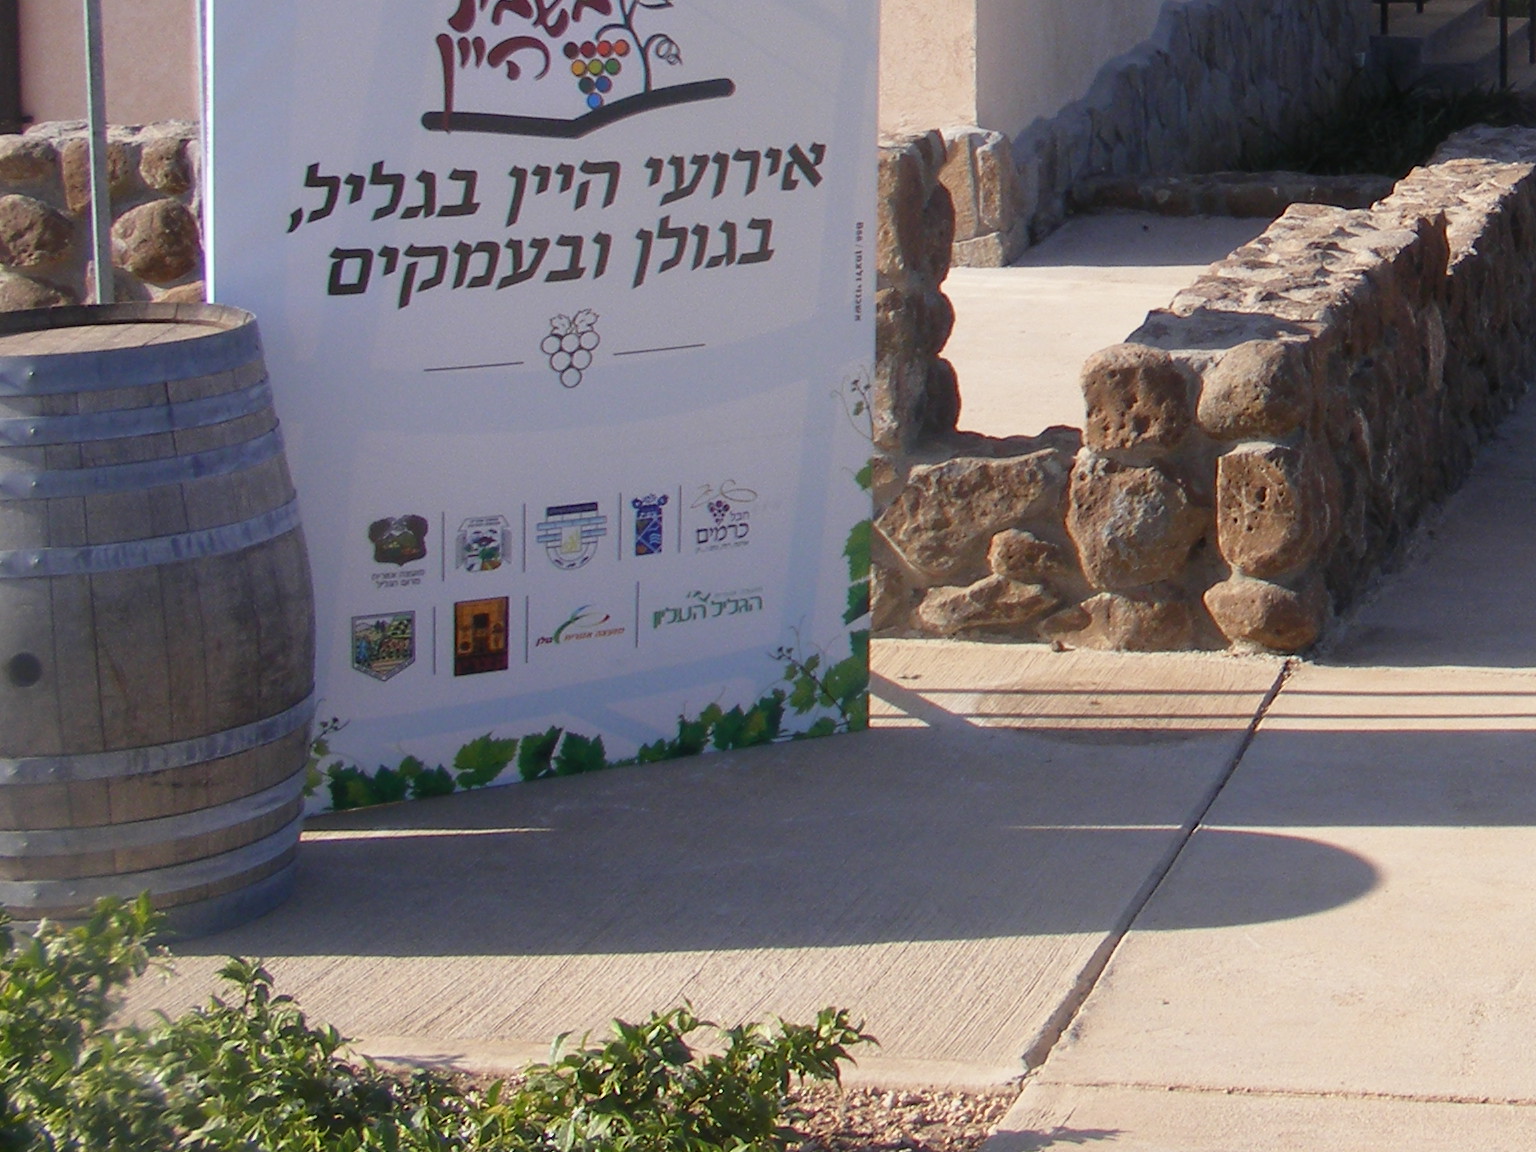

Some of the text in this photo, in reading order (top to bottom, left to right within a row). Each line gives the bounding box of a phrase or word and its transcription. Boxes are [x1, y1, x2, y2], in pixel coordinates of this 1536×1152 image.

[436, 33, 551, 134] היין
[286, 143, 827, 234] אירועי היין בגליל,
[328, 215, 776, 310] בגולן ובעמקים
[695, 522, 750, 545] כרמים
[652, 595, 763, 629] הגליל העליון
